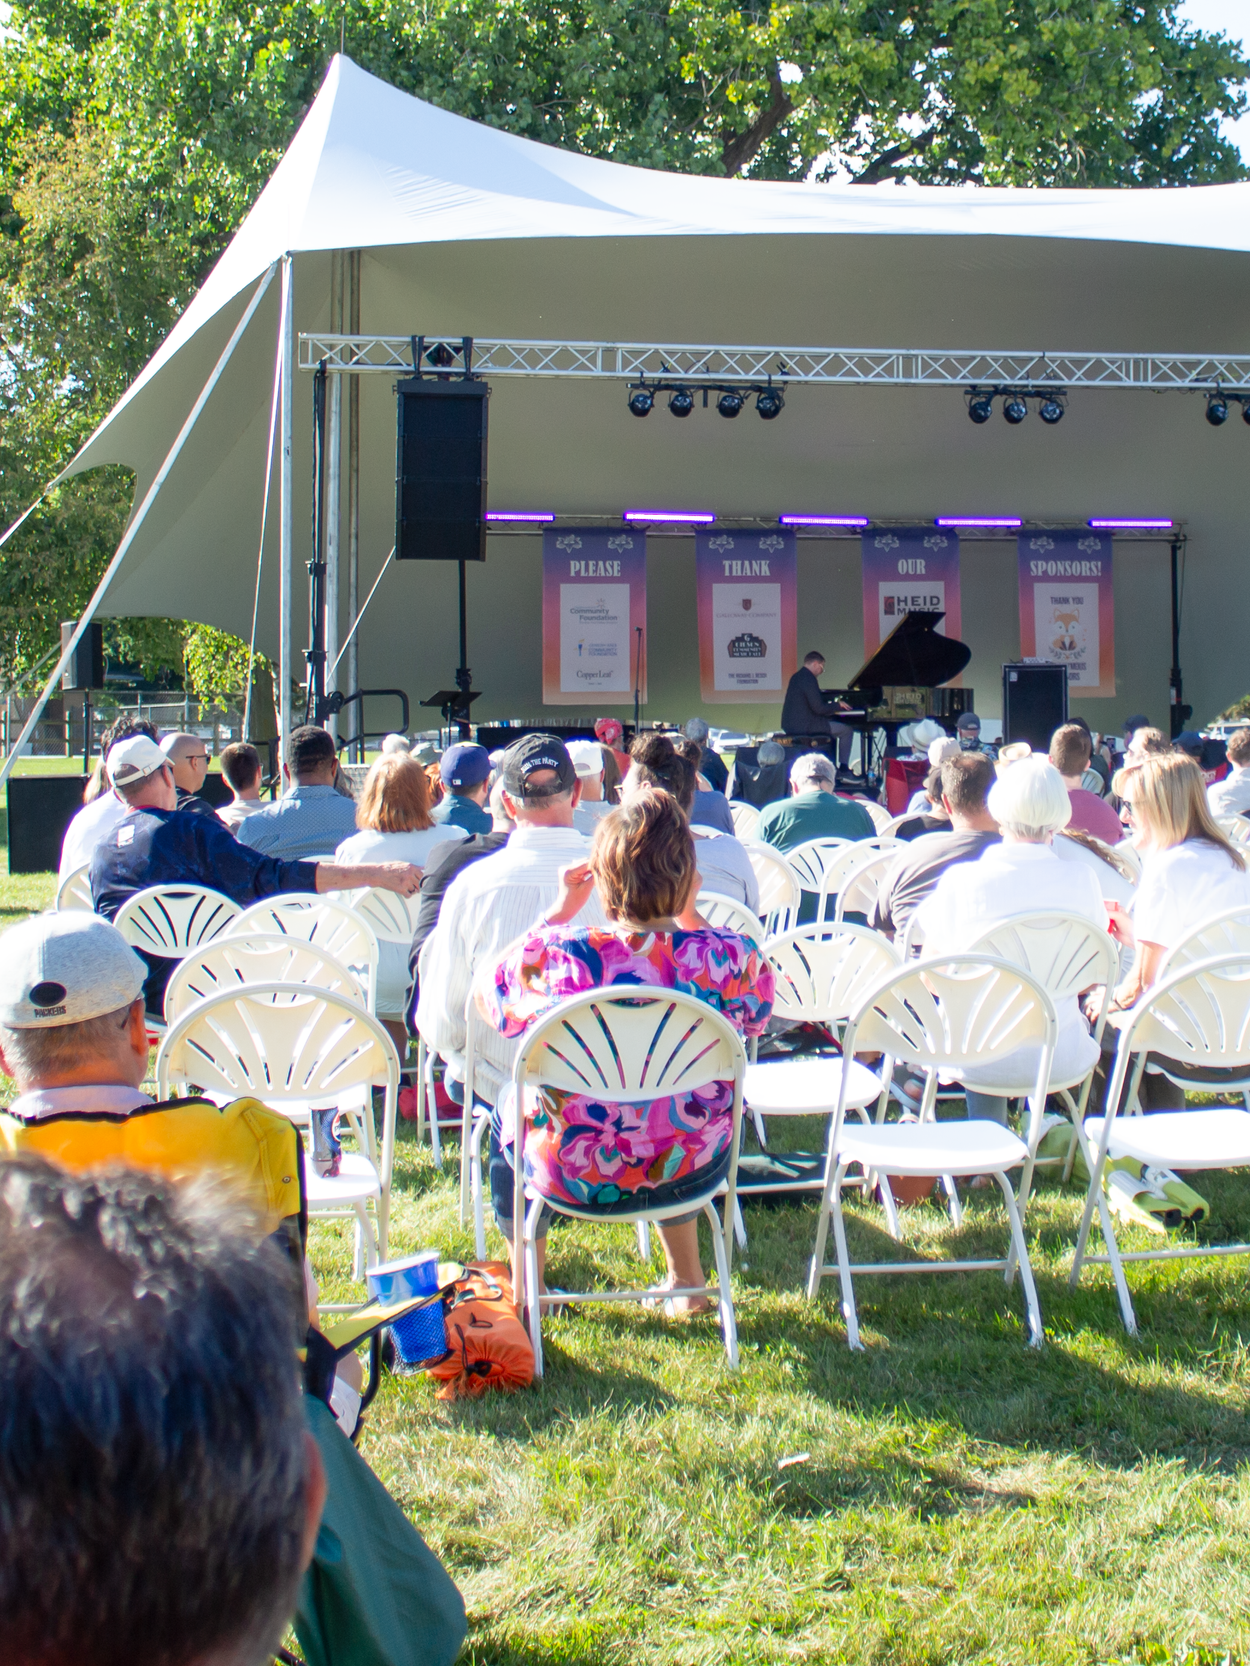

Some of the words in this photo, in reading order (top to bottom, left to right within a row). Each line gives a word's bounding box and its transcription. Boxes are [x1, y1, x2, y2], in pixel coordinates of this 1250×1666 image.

[570, 561, 621, 576] PLEASE
[723, 561, 770, 576] THANK
[898, 559, 926, 574] OUR
[1030, 561, 1102, 576] SPONSORS!
[897, 596, 940, 606] HEID
[1050, 597, 1070, 605] THANK
[1072, 597, 1084, 605] YOU
[530, 758, 541, 766] THE
[542, 756, 559, 767] PARTY
[34, 1006, 66, 1018] PACKERS
